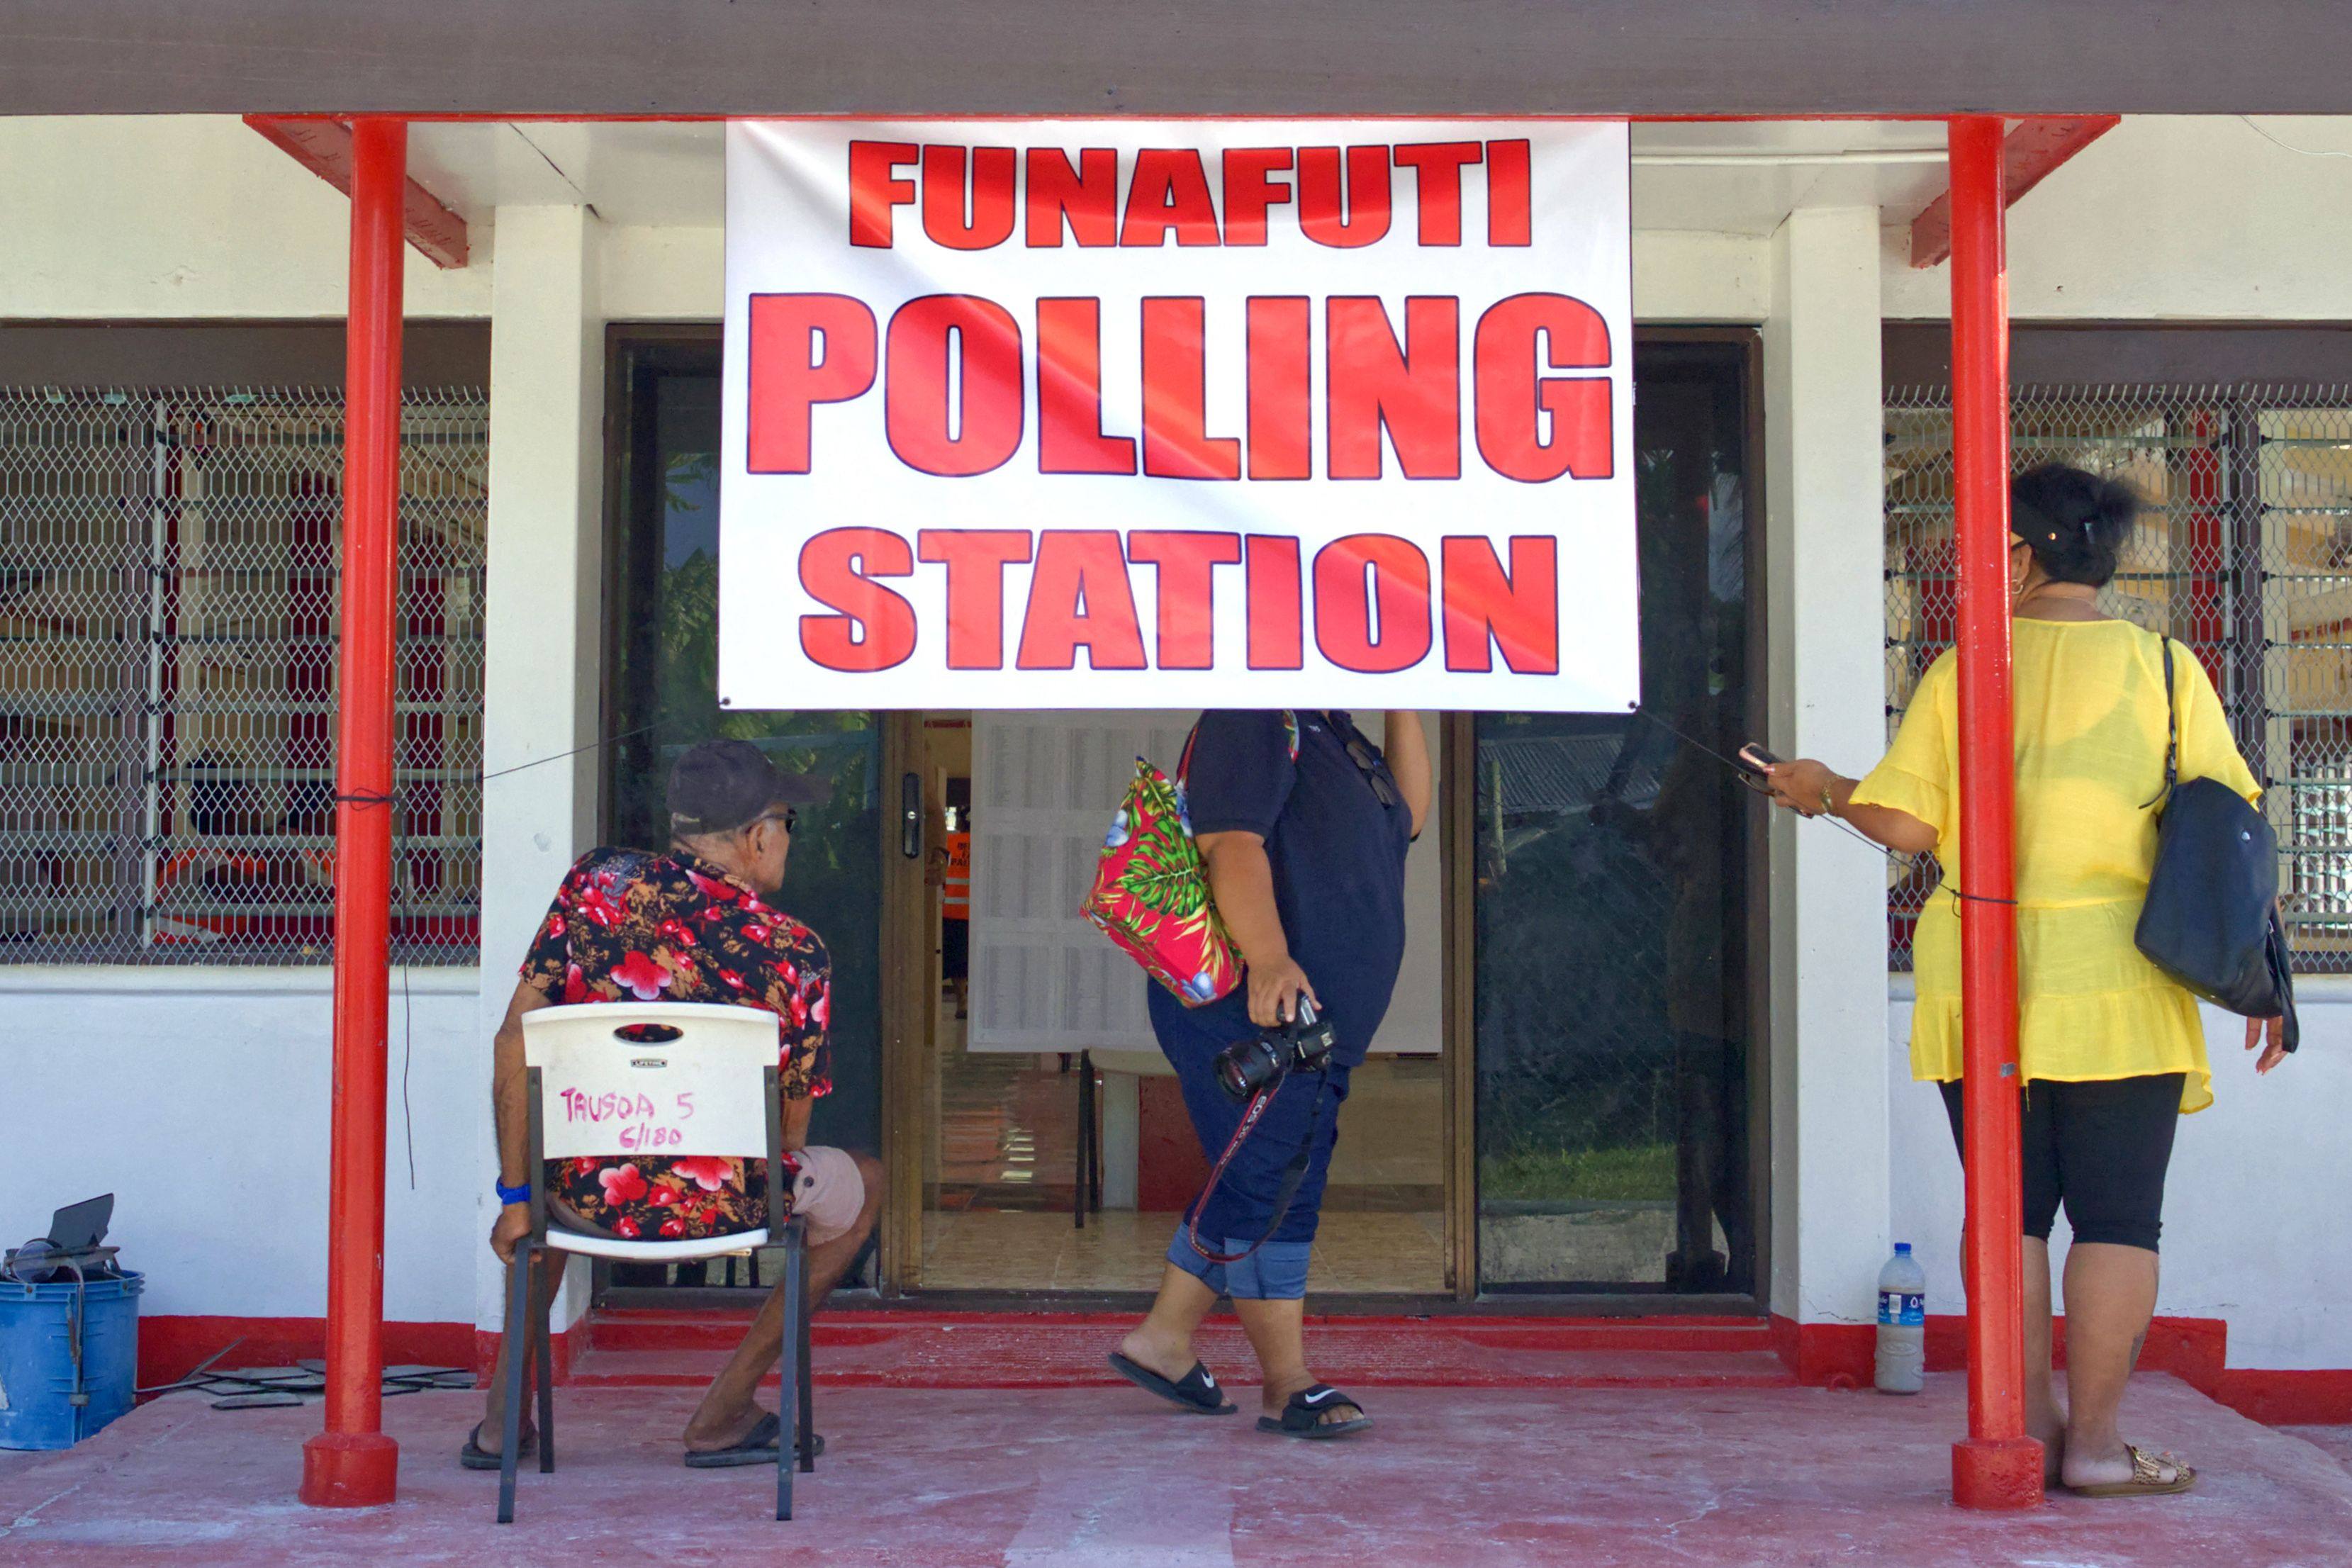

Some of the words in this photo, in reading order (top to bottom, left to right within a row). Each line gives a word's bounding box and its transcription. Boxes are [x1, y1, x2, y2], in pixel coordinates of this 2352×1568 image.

[849, 139, 1532, 251] FUNAFUTI
[746, 292, 1614, 483] POLLING
[798, 527, 1559, 676] STATION
[676, 1092, 695, 1120] 5
